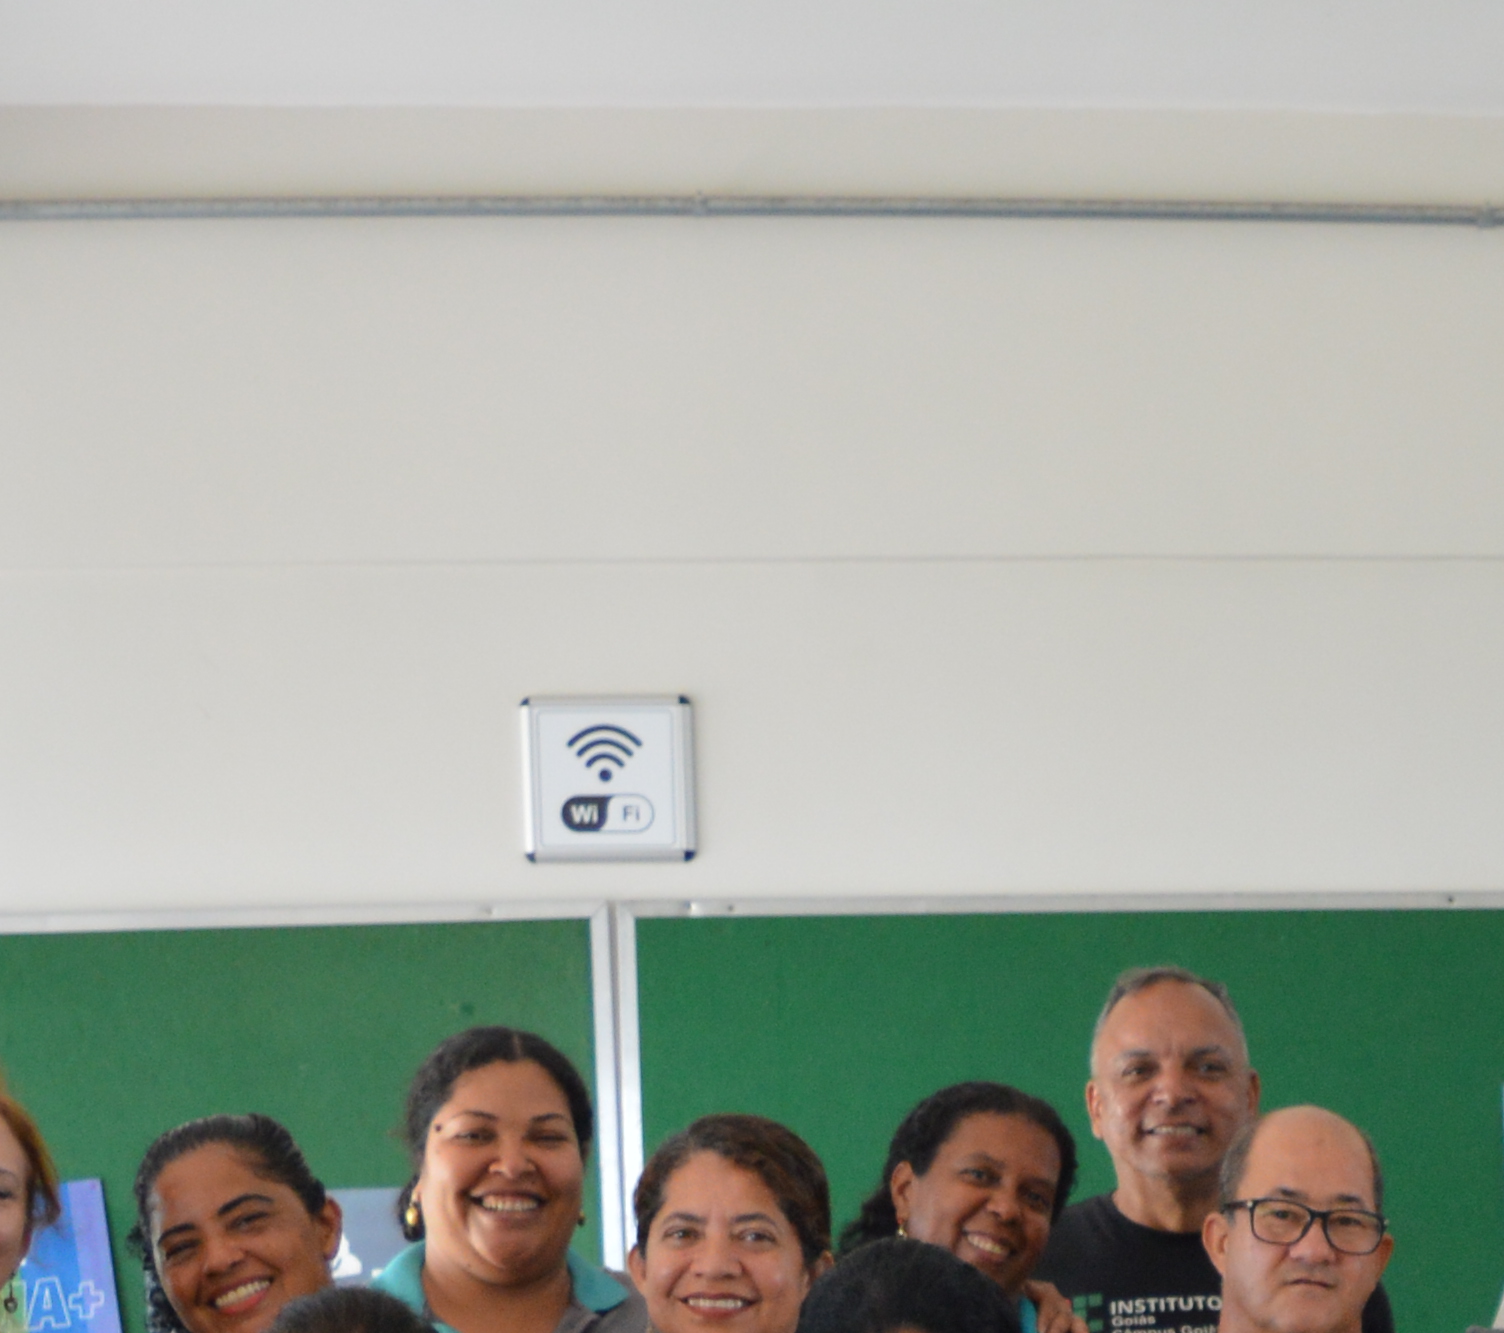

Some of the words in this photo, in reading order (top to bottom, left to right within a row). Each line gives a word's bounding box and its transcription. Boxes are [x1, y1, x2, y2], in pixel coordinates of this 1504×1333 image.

[570, 803, 599, 825] Wi
[622, 803, 640, 822] Fi
[1109, 1295, 1223, 1316] INSTITUTO
[1111, 1314, 1156, 1327] Goiás
